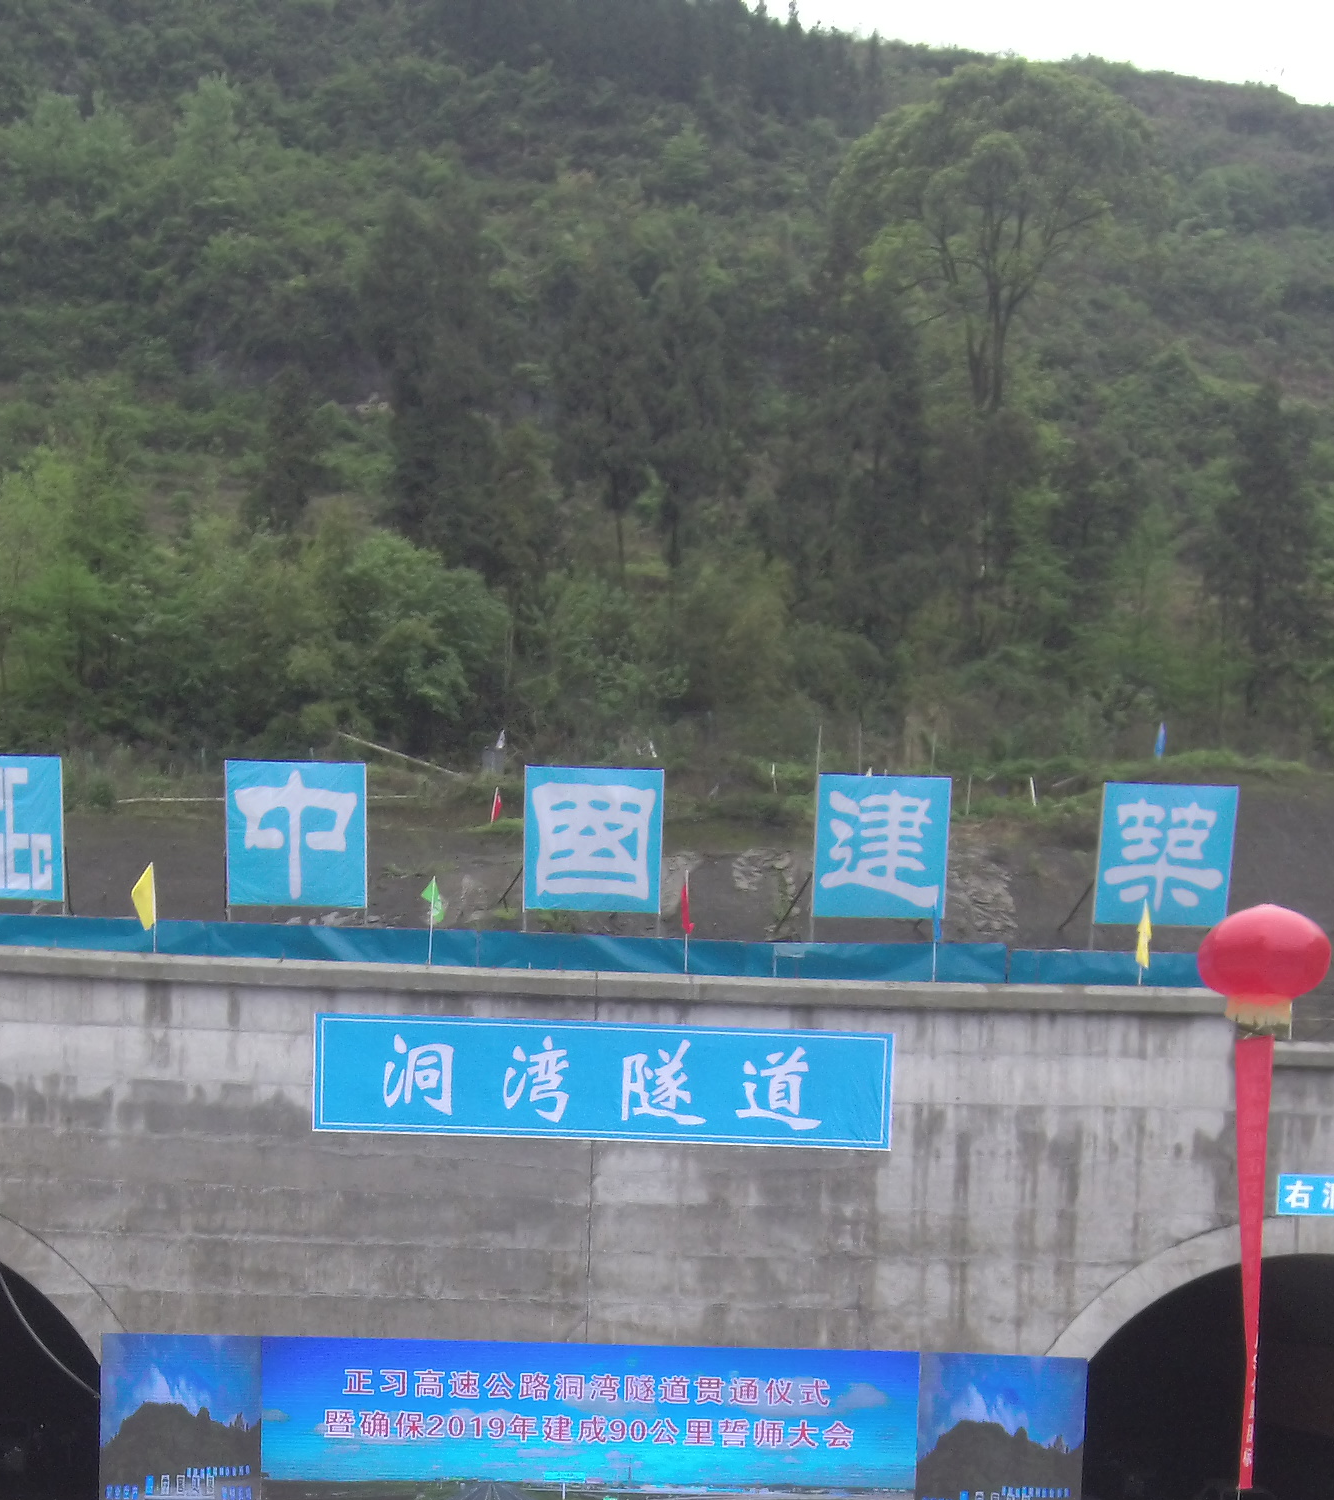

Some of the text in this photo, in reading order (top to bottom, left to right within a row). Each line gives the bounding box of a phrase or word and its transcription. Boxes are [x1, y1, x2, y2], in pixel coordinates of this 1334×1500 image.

[383, 1033, 821, 1131] 洞湾隧道
[342, 1368, 831, 1407] 正习高速公路洞湾隧道贯通仪式
[324, 1409, 854, 1449] 暨确保2019年建成90公里誓师大会
